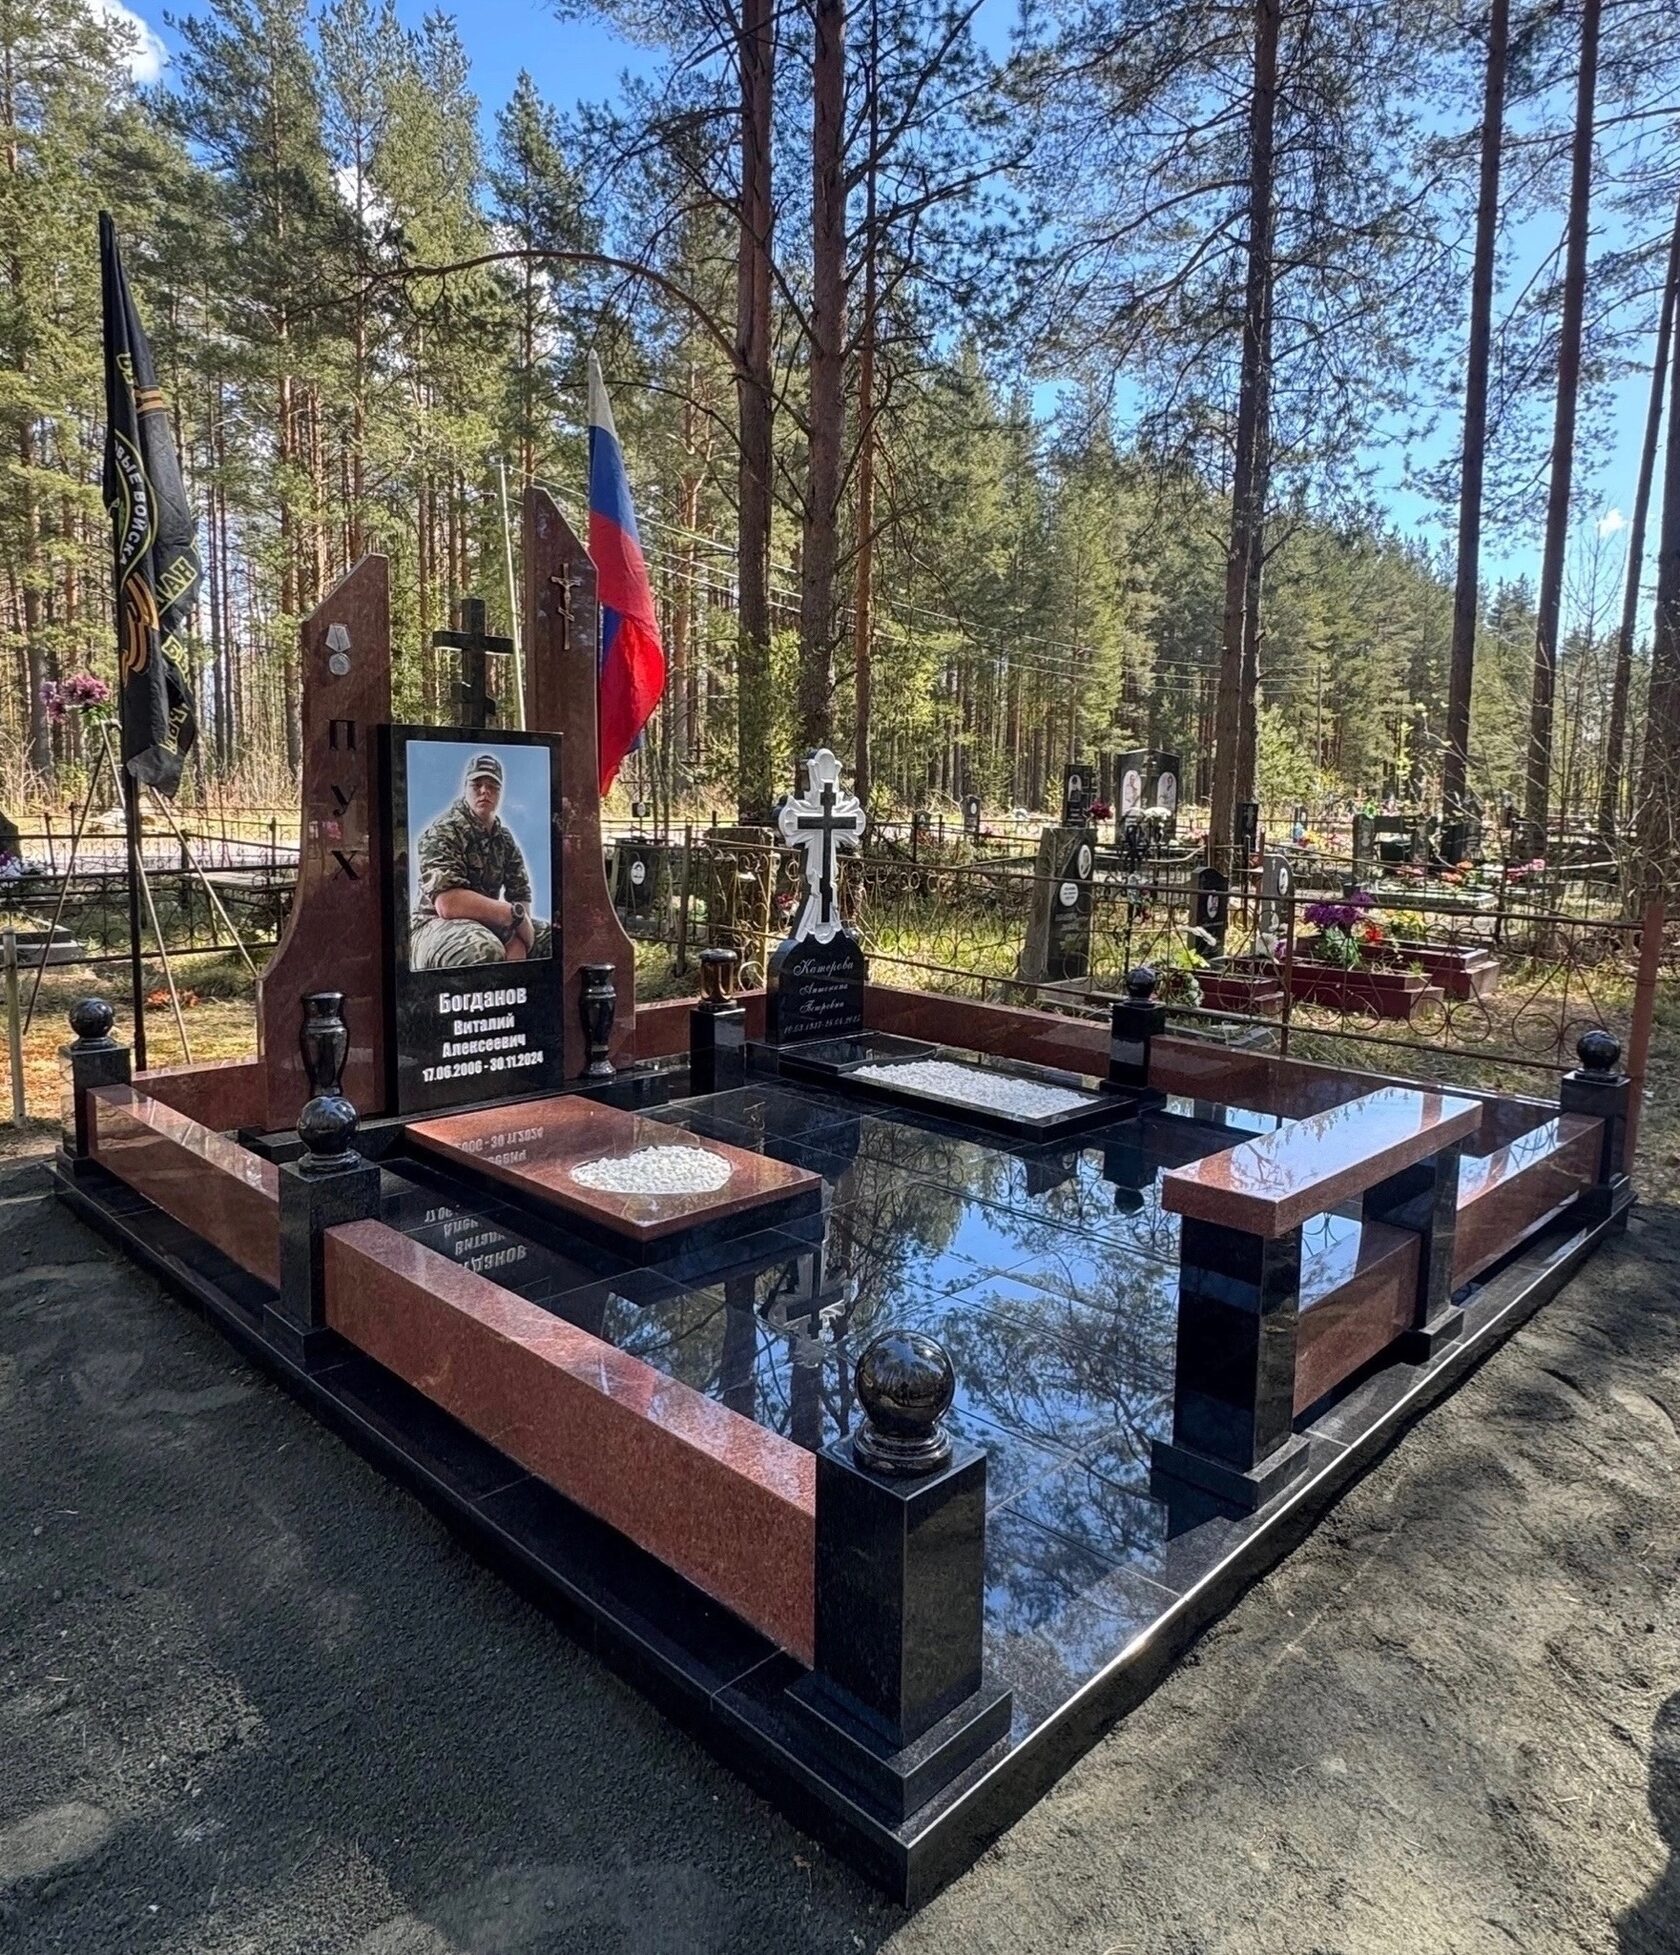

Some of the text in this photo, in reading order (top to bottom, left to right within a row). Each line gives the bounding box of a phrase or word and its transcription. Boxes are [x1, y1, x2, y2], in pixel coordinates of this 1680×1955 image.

[439, 987, 527, 1014] Богданов
[453, 1012, 515, 1036] Виталий
[442, 1033, 526, 1058] Алексеевич
[422, 1060, 482, 1082] 17.06.2006
[490, 1050, 544, 1071] 30.11.2024
